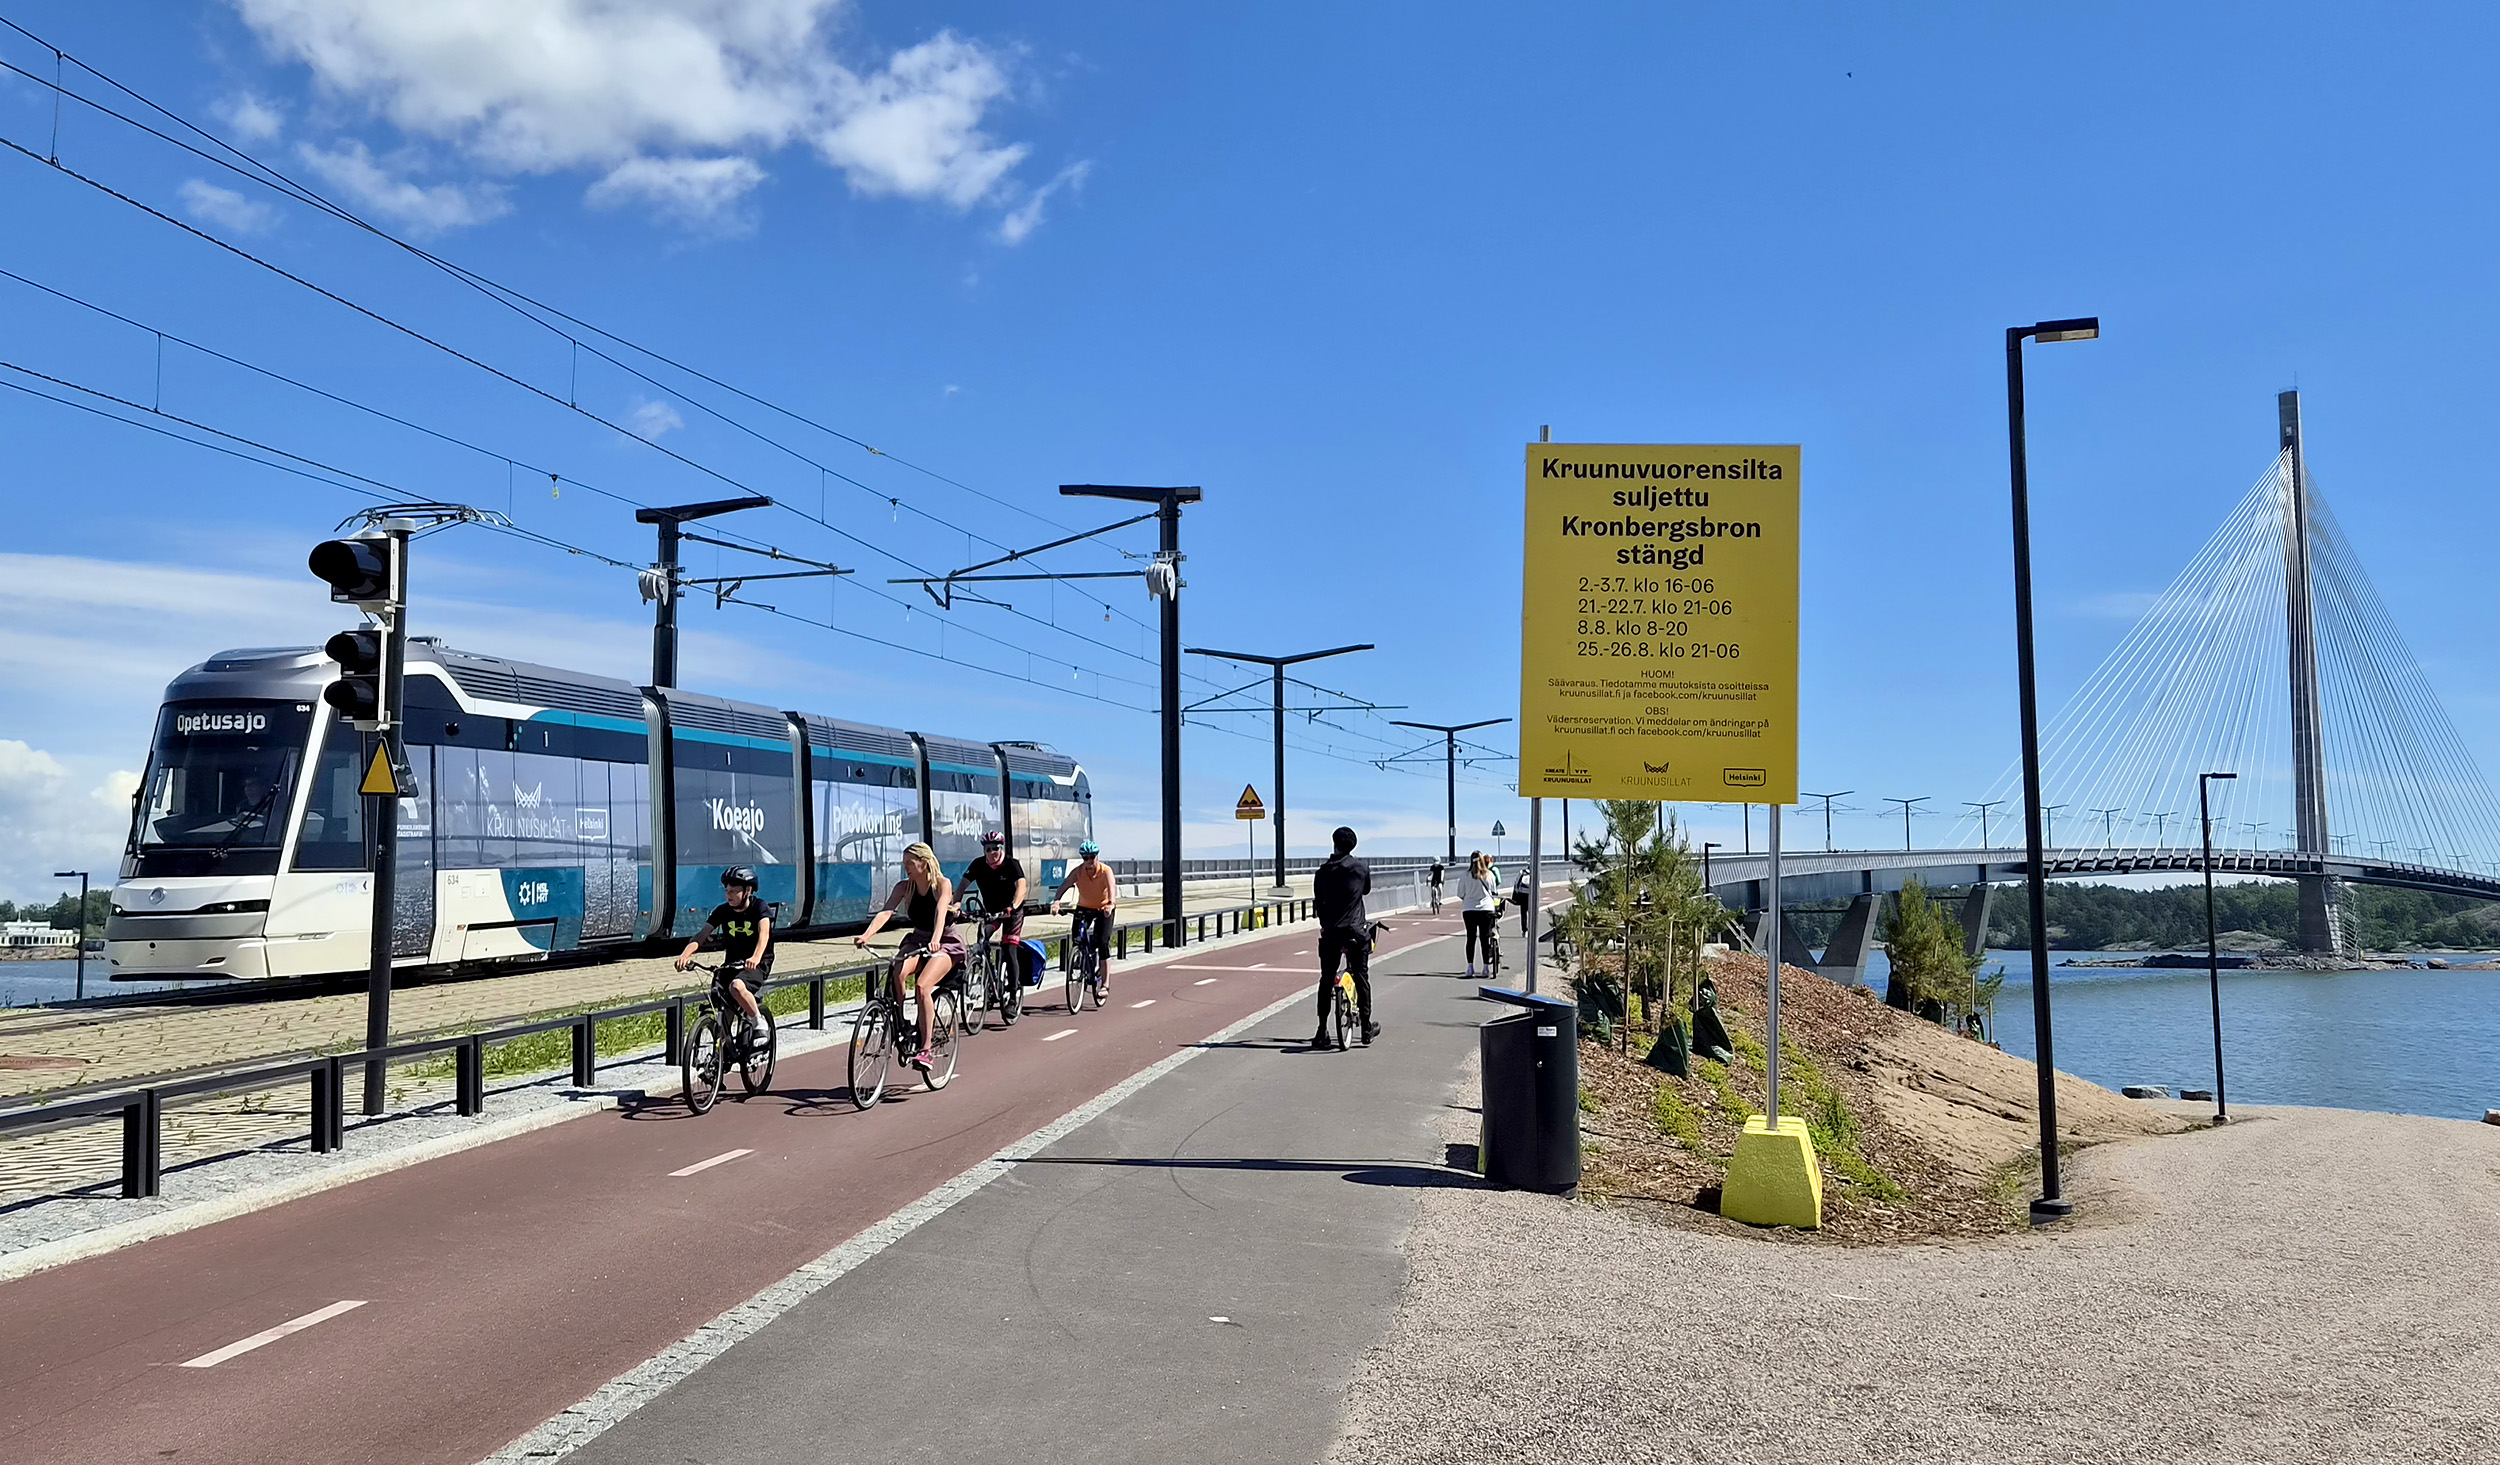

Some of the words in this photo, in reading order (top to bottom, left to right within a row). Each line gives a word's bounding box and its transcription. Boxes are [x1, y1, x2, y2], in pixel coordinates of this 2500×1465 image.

[1542, 458, 1783, 480] Kruunuvuorensilta
[1612, 485, 1709, 512] suljettu
[1562, 515, 1761, 543] Kronbergsbron
[1616, 544, 1704, 570] stängd
[1579, 577, 1628, 592] 2.-3.7.
[1634, 577, 1659, 593] klo
[1665, 578, 1714, 593] 16-06
[1578, 599, 1647, 614] 21.-22.7.
[1652, 599, 1677, 615] klo
[1683, 600, 1732, 615] 21-06
[1577, 620, 1611, 635] 8.8.
[1616, 620, 1641, 635] klo
[1647, 621, 1688, 636] 8-20
[1577, 642, 1654, 657] 25.-26.8.
[1659, 642, 1685, 658] klo
[1691, 643, 1740, 658] 21-06
[1641, 670, 1674, 678] HUOM!
[1548, 678, 1598, 688] Säävaraus.
[1600, 679, 1657, 688] Tiedotamme
[1659, 681, 1716, 690] muutoksista
[1718, 682, 1769, 691] osoitteissa
[1559, 689, 1621, 698] kruunusillat.fi
[1622, 690, 1631, 700] ja
[1633, 690, 1757, 701] facebook.com/kruunusillat
[1645, 706, 1669, 715] OBS!
[177, 712, 266, 735] Opetusajo
[1546, 715, 1634, 725] Vädersreservation.
[1635, 717, 1645, 725] Vi
[1646, 717, 1691, 725] meddelar
[1709, 718, 1756, 728] ändringar
[1757, 719, 1770, 729] på
[1554, 725, 1616, 735] kruunusillat.fi
[1617, 726, 1635, 735] och
[1637, 726, 1761, 738] facebook.com/kruunusillat
[1620, 776, 1692, 787] KRUUNUSILLAT
[1729, 773, 1761, 782] Helsinki
[712, 797, 765, 839] Koeajo
[952, 812, 983, 841] Koeajo
[447, 874, 459, 886] 634
